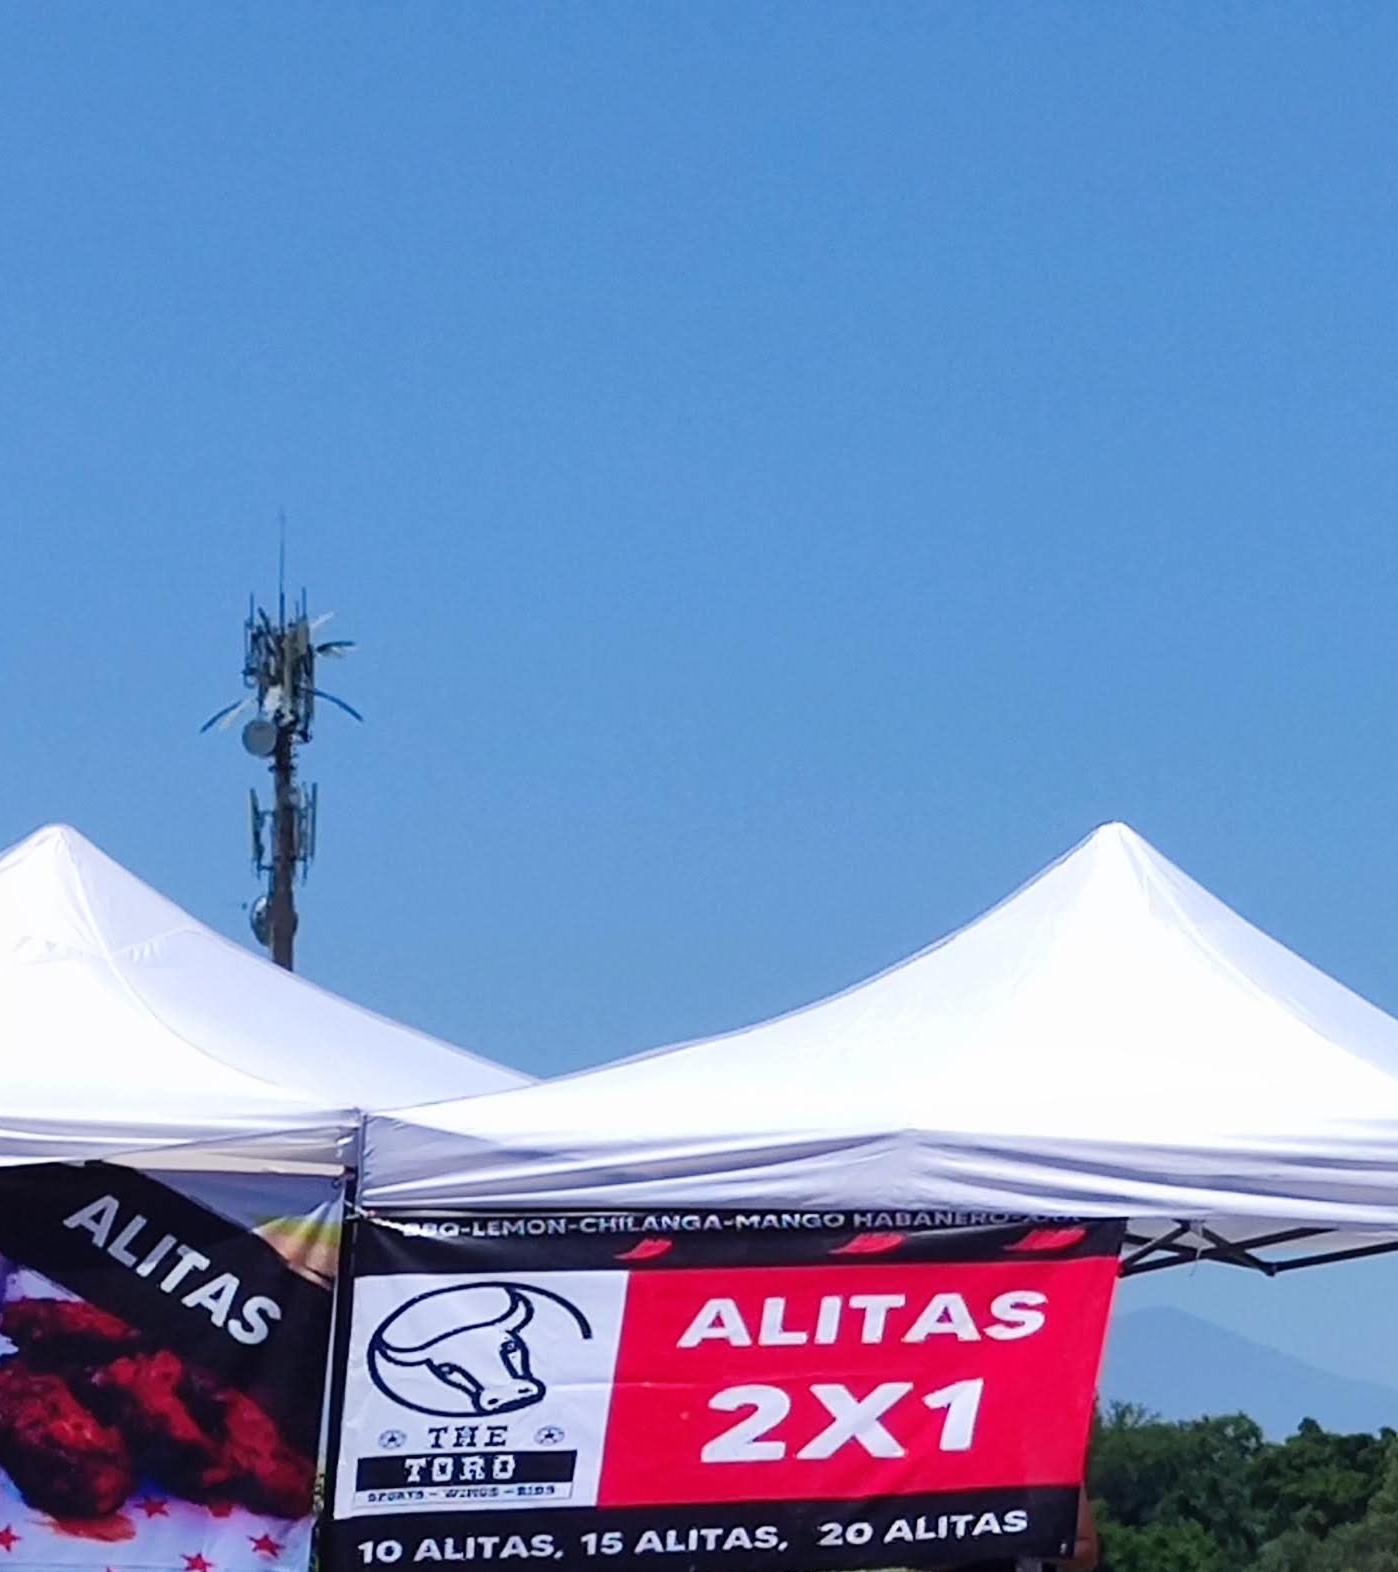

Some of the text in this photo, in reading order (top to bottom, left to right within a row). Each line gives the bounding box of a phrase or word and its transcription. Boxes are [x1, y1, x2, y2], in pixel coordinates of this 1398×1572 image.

[853, 1212, 1081, 1227] HABANERO-
[62, 1193, 284, 1346] ALITAS
[677, 1290, 1049, 1349] ALITAS
[428, 1425, 508, 1449] THE
[700, 1377, 985, 1463] 2X1
[404, 1454, 515, 1483] TORO
[516, 1485, 555, 1497] RIBS
[358, 1509, 1029, 1565] 10 ALITAS, 15 ALITAS, 20 ALITAS
